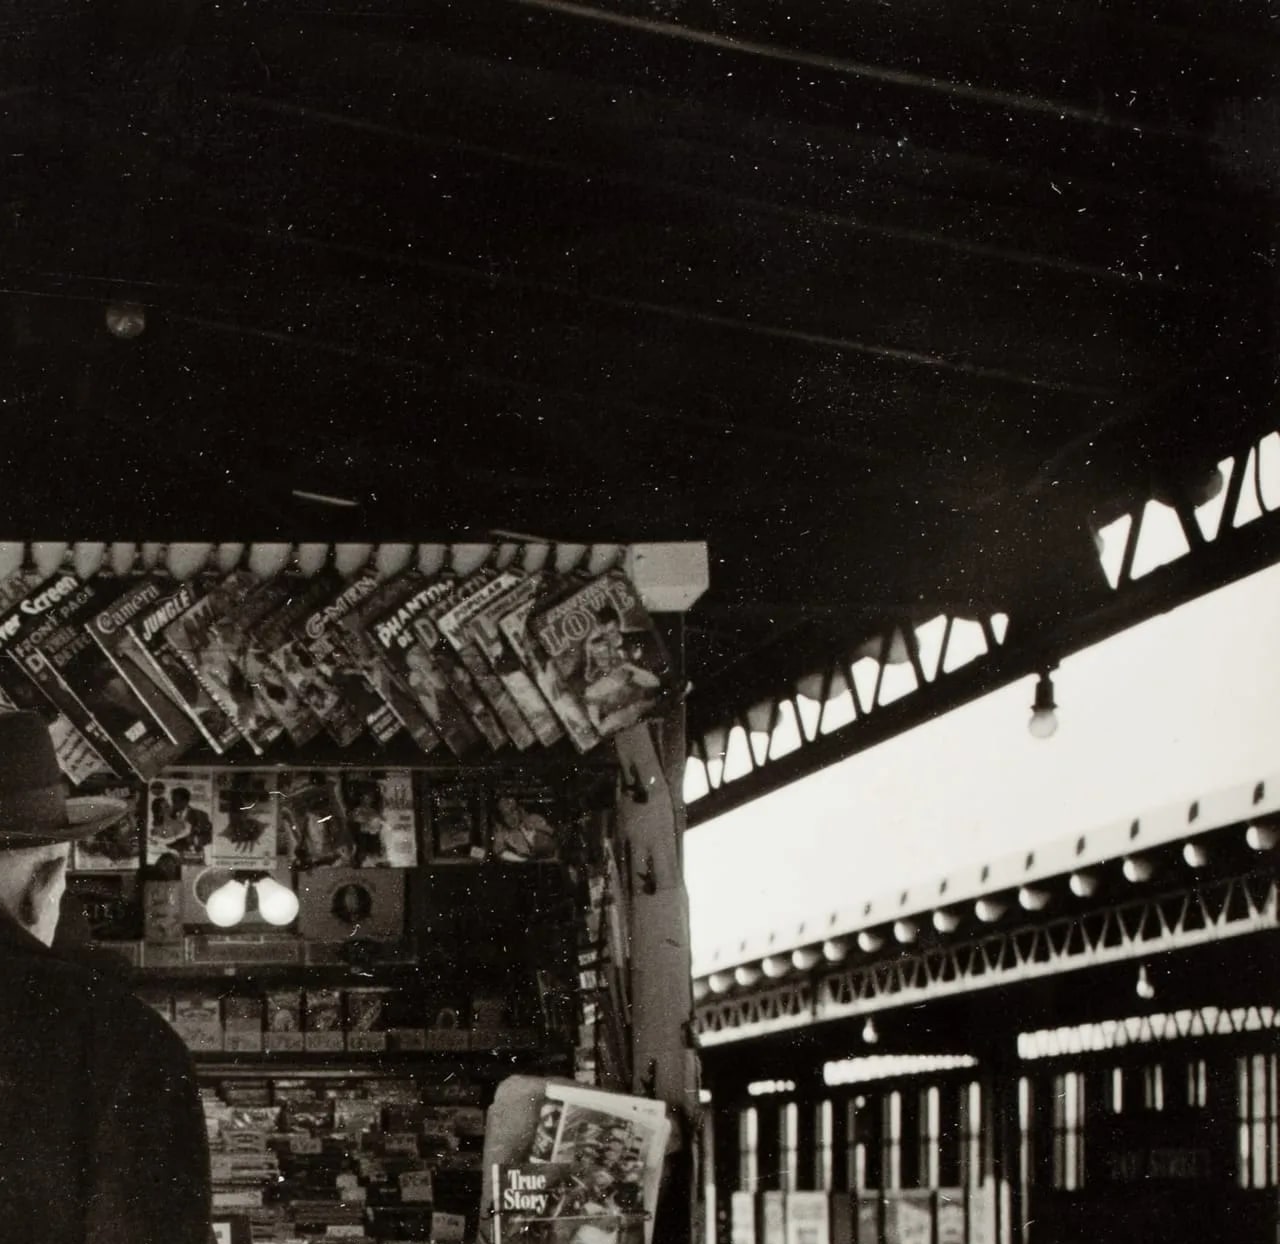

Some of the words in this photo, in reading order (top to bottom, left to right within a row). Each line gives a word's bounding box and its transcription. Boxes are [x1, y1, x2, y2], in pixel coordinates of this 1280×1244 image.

[19, 573, 78, 617] Screen
[92, 582, 159, 637] Camera
[136, 588, 193, 640] JUNGLE
[373, 577, 454, 647] PHANTOM
[503, 1188, 549, 1214] Story
[507, 1168, 546, 1190] True
